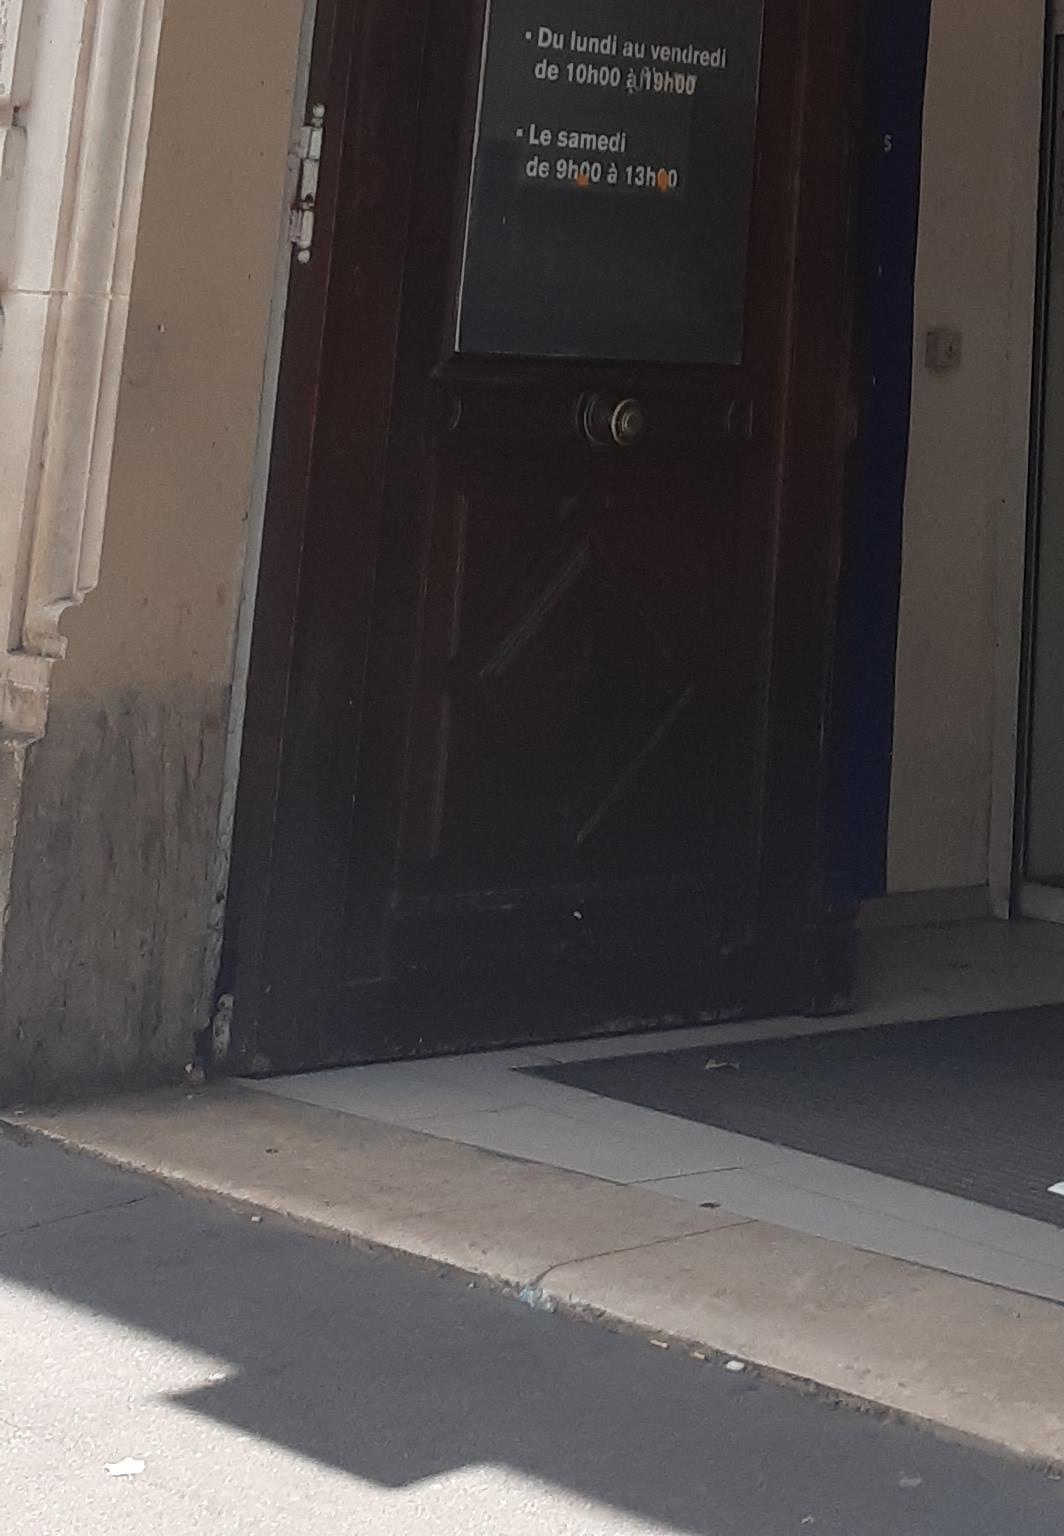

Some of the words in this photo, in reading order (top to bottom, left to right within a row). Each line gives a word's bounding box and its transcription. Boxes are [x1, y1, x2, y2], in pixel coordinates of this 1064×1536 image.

[537, 26, 564, 49] Du
[570, 30, 617, 56] lundi
[622, 40, 645, 59] au
[650, 43, 727, 69] vendredi
[534, 59, 559, 81] de
[566, 62, 620, 87] 10h00
[529, 123, 552, 146] Le
[557, 131, 626, 153] samedi
[526, 155, 549, 178] de
[556, 158, 601, 184] 9h00
[607, 163, 618, 185] à
